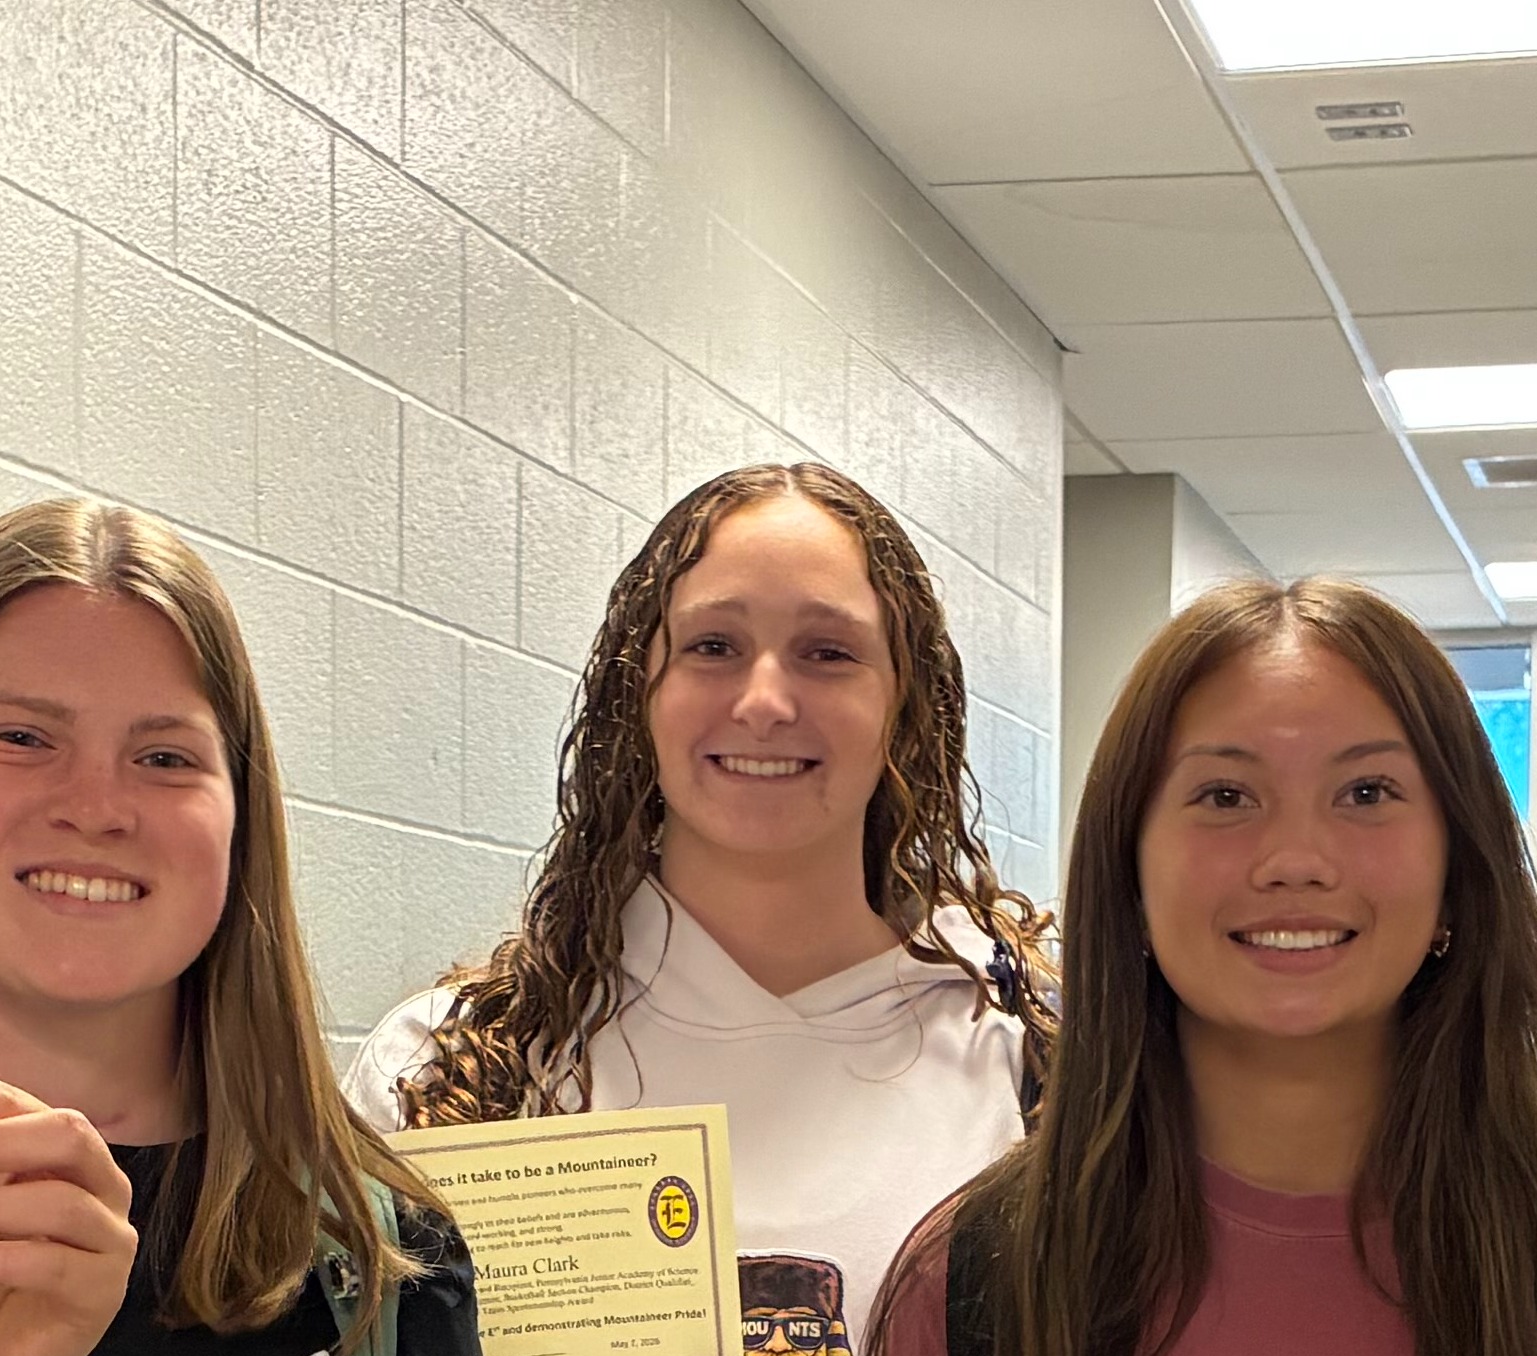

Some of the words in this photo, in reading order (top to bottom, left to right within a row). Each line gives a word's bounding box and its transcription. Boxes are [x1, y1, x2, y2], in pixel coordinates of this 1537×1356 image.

[457, 1173, 468, 1185] it
[471, 1170, 502, 1184] take
[506, 1169, 520, 1180] to
[524, 1165, 542, 1177] be
[545, 1166, 554, 1175] a
[558, 1153, 657, 1174] Mountaineer?
[474, 1264, 528, 1280] Maura
[533, 1255, 580, 1274] Clark
[503, 1325, 522, 1335] and
[525, 1317, 602, 1333] demonstrating
[604, 1312, 672, 1325] Mountaineer
[789, 1322, 820, 1337] NTS
